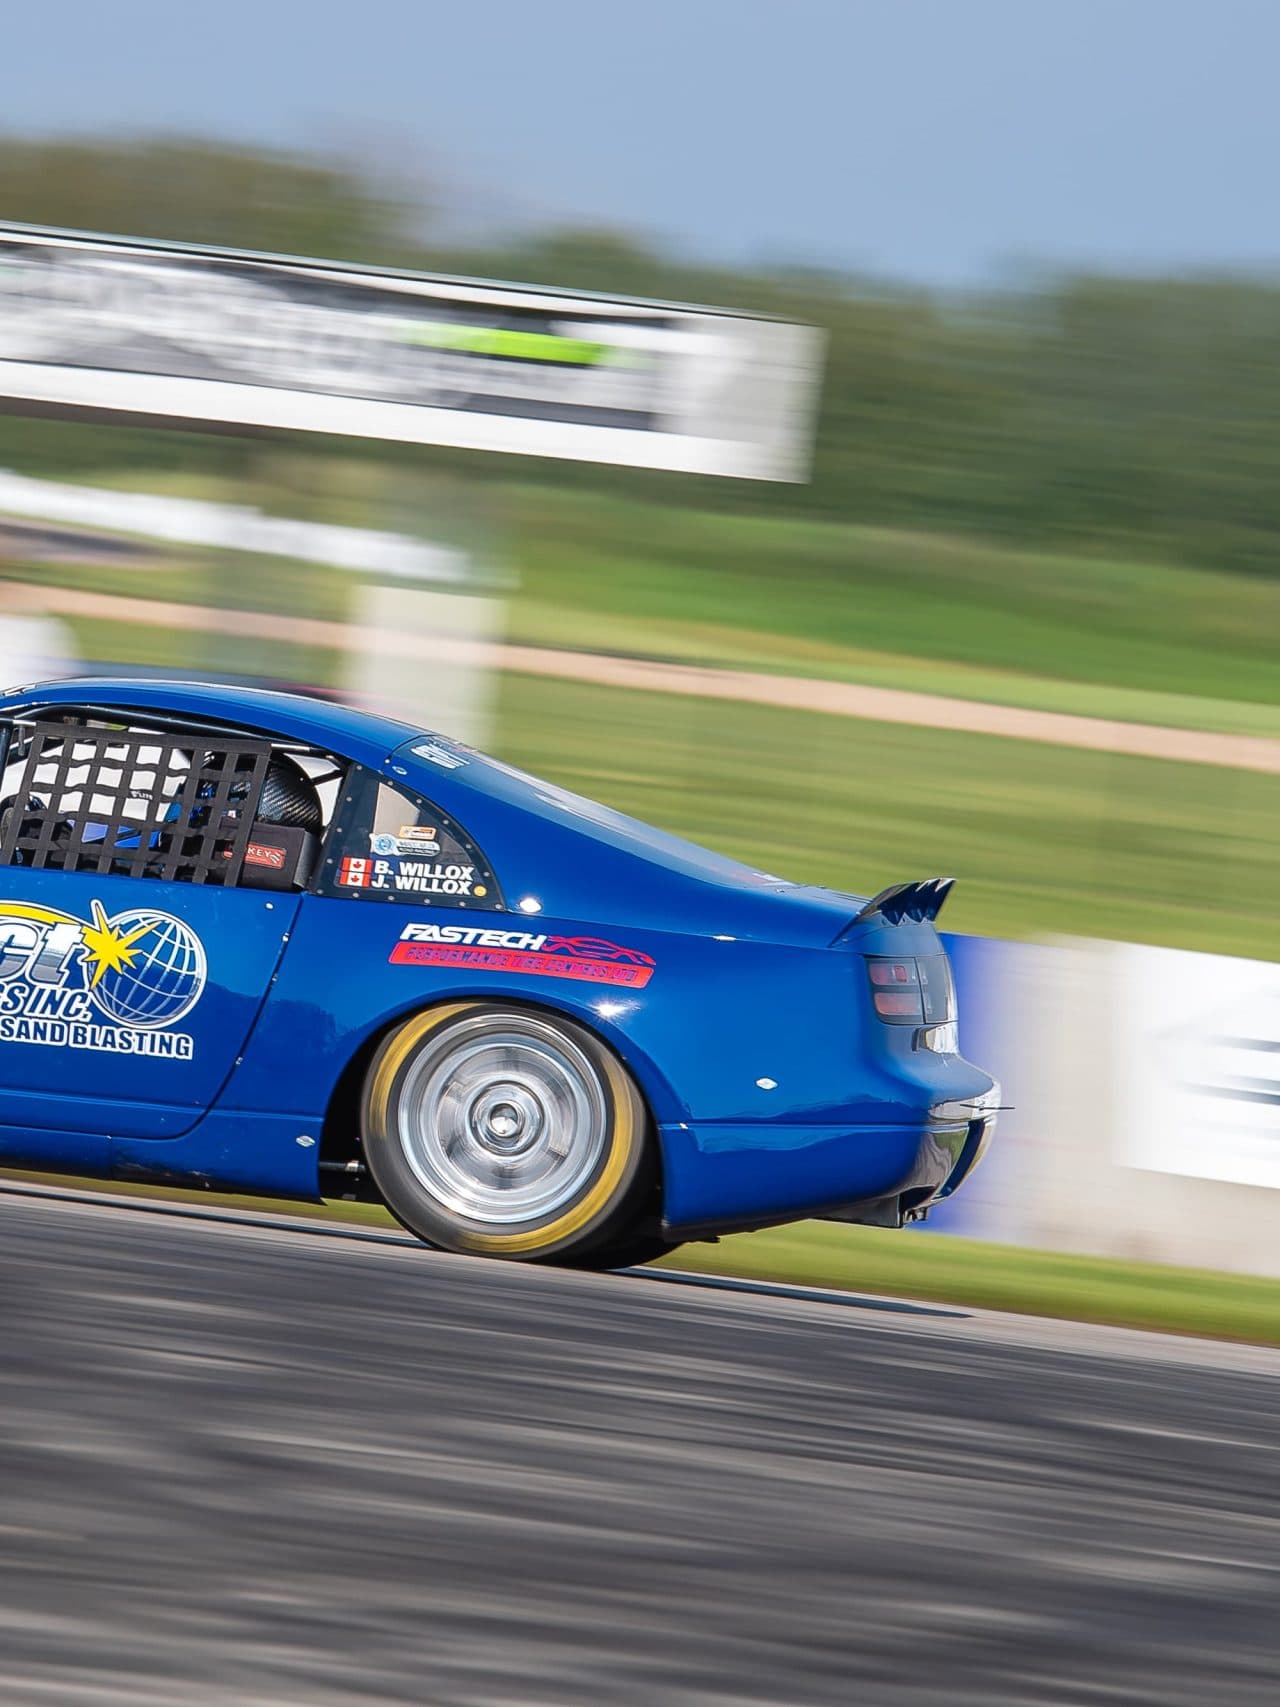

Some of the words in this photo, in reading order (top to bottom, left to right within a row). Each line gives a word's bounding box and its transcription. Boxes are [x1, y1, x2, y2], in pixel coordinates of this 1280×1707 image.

[371, 875, 390, 889] J.
[394, 876, 473, 896] WILLOX
[374, 860, 394, 875] B.
[399, 861, 475, 882] WILLOX
[400, 922, 547, 951] FASTECH
[26, 986, 93, 1023] INC.
[71, 1022, 195, 1060] BLASTING
